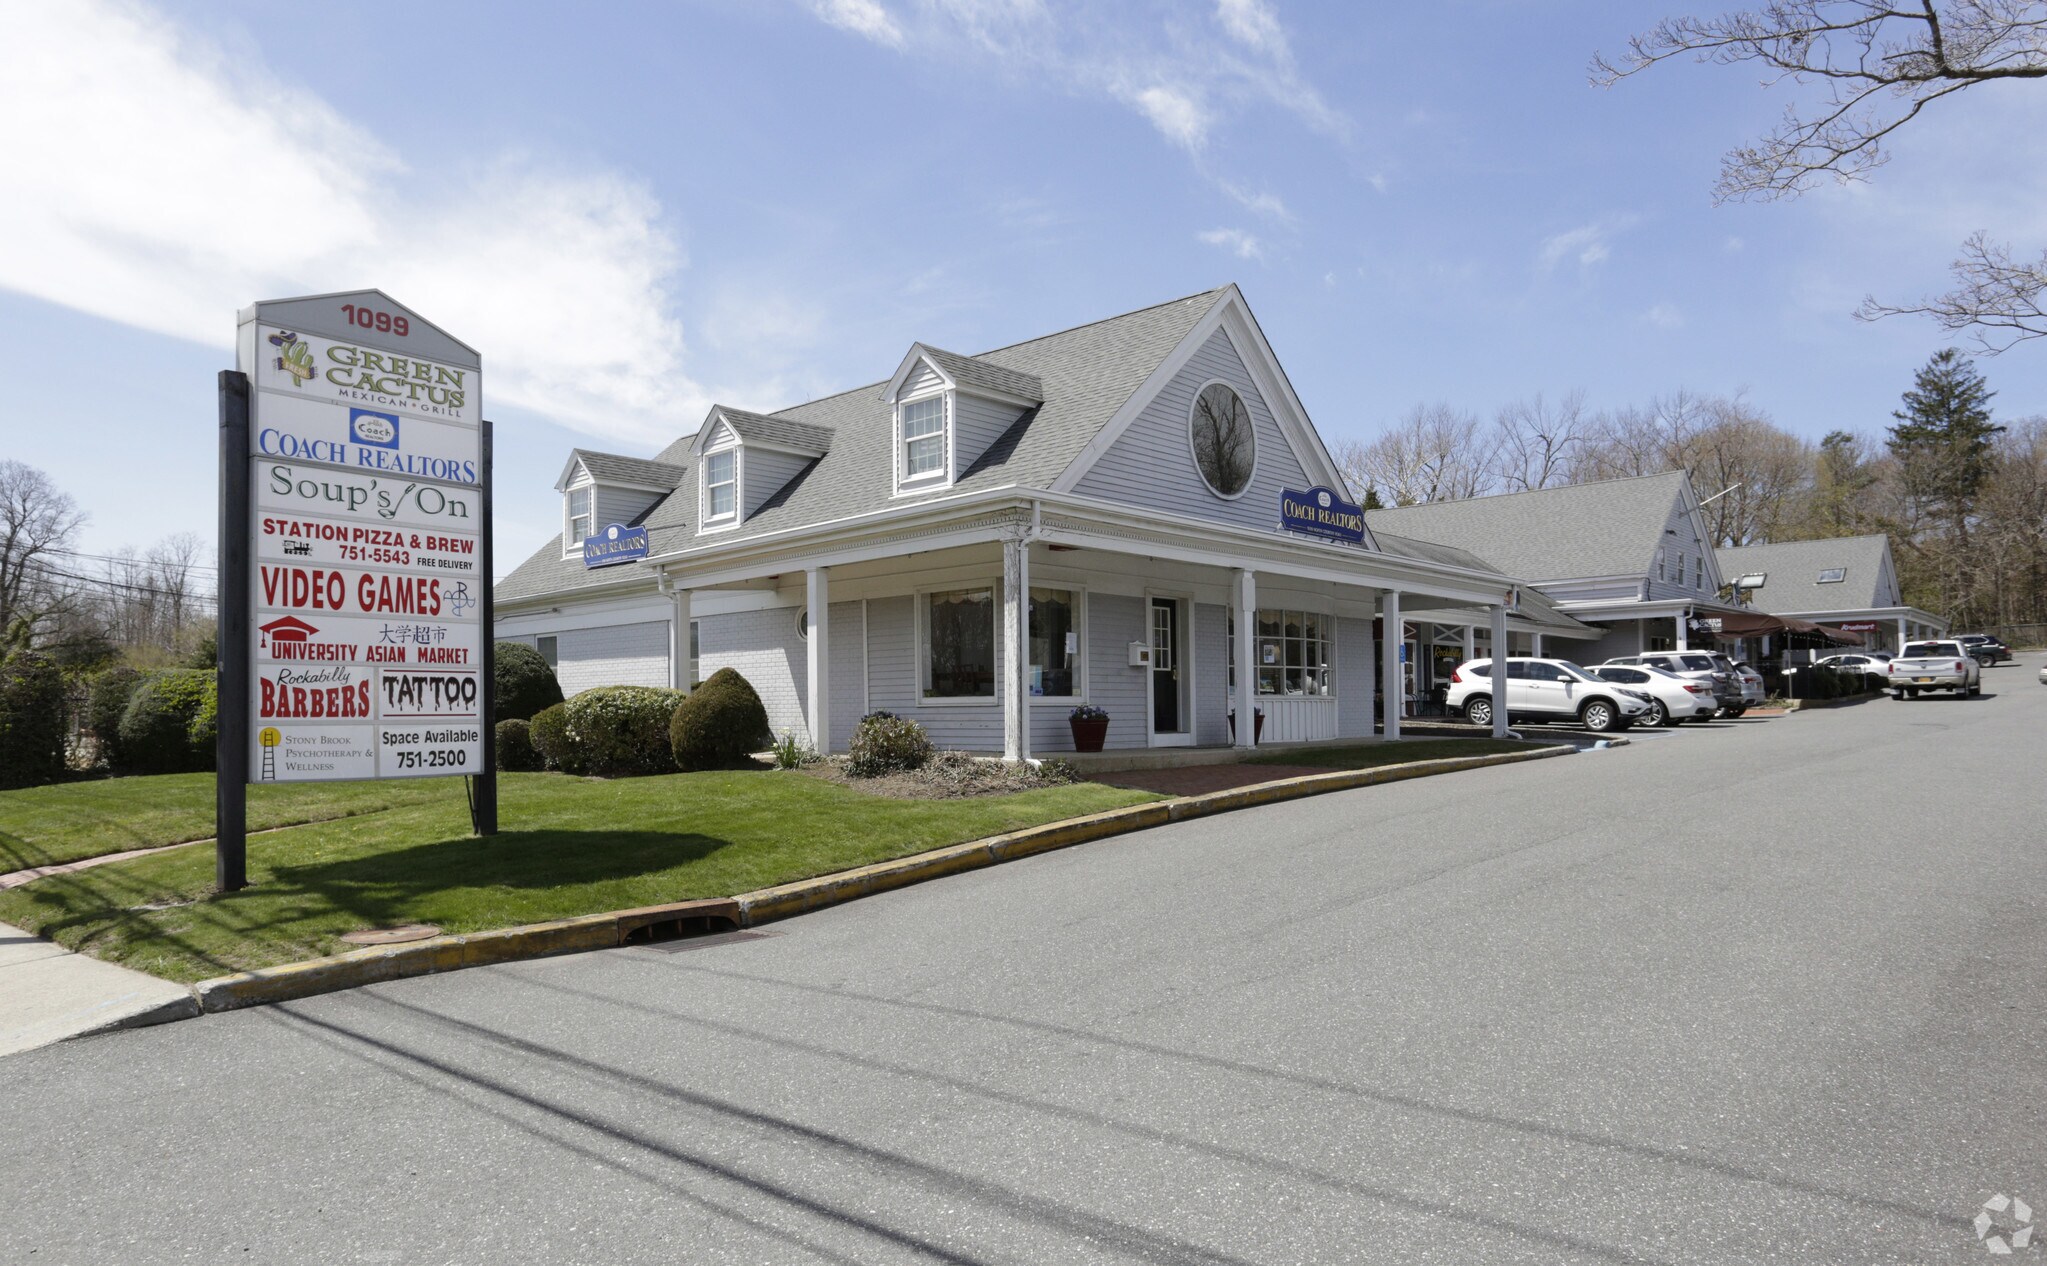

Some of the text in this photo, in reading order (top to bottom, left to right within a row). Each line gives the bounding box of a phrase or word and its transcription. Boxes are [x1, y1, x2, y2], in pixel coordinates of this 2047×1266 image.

[341, 304, 409, 337] 1099
[326, 345, 465, 389] GREEN
[326, 367, 465, 408] CACTUS
[339, 389, 461, 418] MEXICAN GRILL
[358, 423, 391, 437] Coach
[259, 428, 475, 484] COACH REALTORS
[270, 465, 469, 519] Soup's On
[1284, 499, 1315, 521] COACH
[1318, 509, 1362, 532] REALTORS
[263, 518, 474, 554] STATION PIZZA & BREW
[339, 545, 473, 570] 751-5543 FREE DELIVERY
[261, 566, 441, 616] VIDEO GAMES
[379, 624, 447, 645] 大学超市
[272, 642, 469, 664] UNIVERSITY ASIAN MARKET
[277, 666, 351, 687] Rockabilly
[260, 676, 370, 718] BARBERS
[383, 674, 477, 711] TATTOO
[286, 735, 351, 745] STONY BROOK
[286, 748, 373, 758] PSYCHOTHERAPY &
[382, 730, 478, 747] Space Available
[286, 762, 334, 771] WELLNESS
[397, 750, 466, 769] 751-2500
